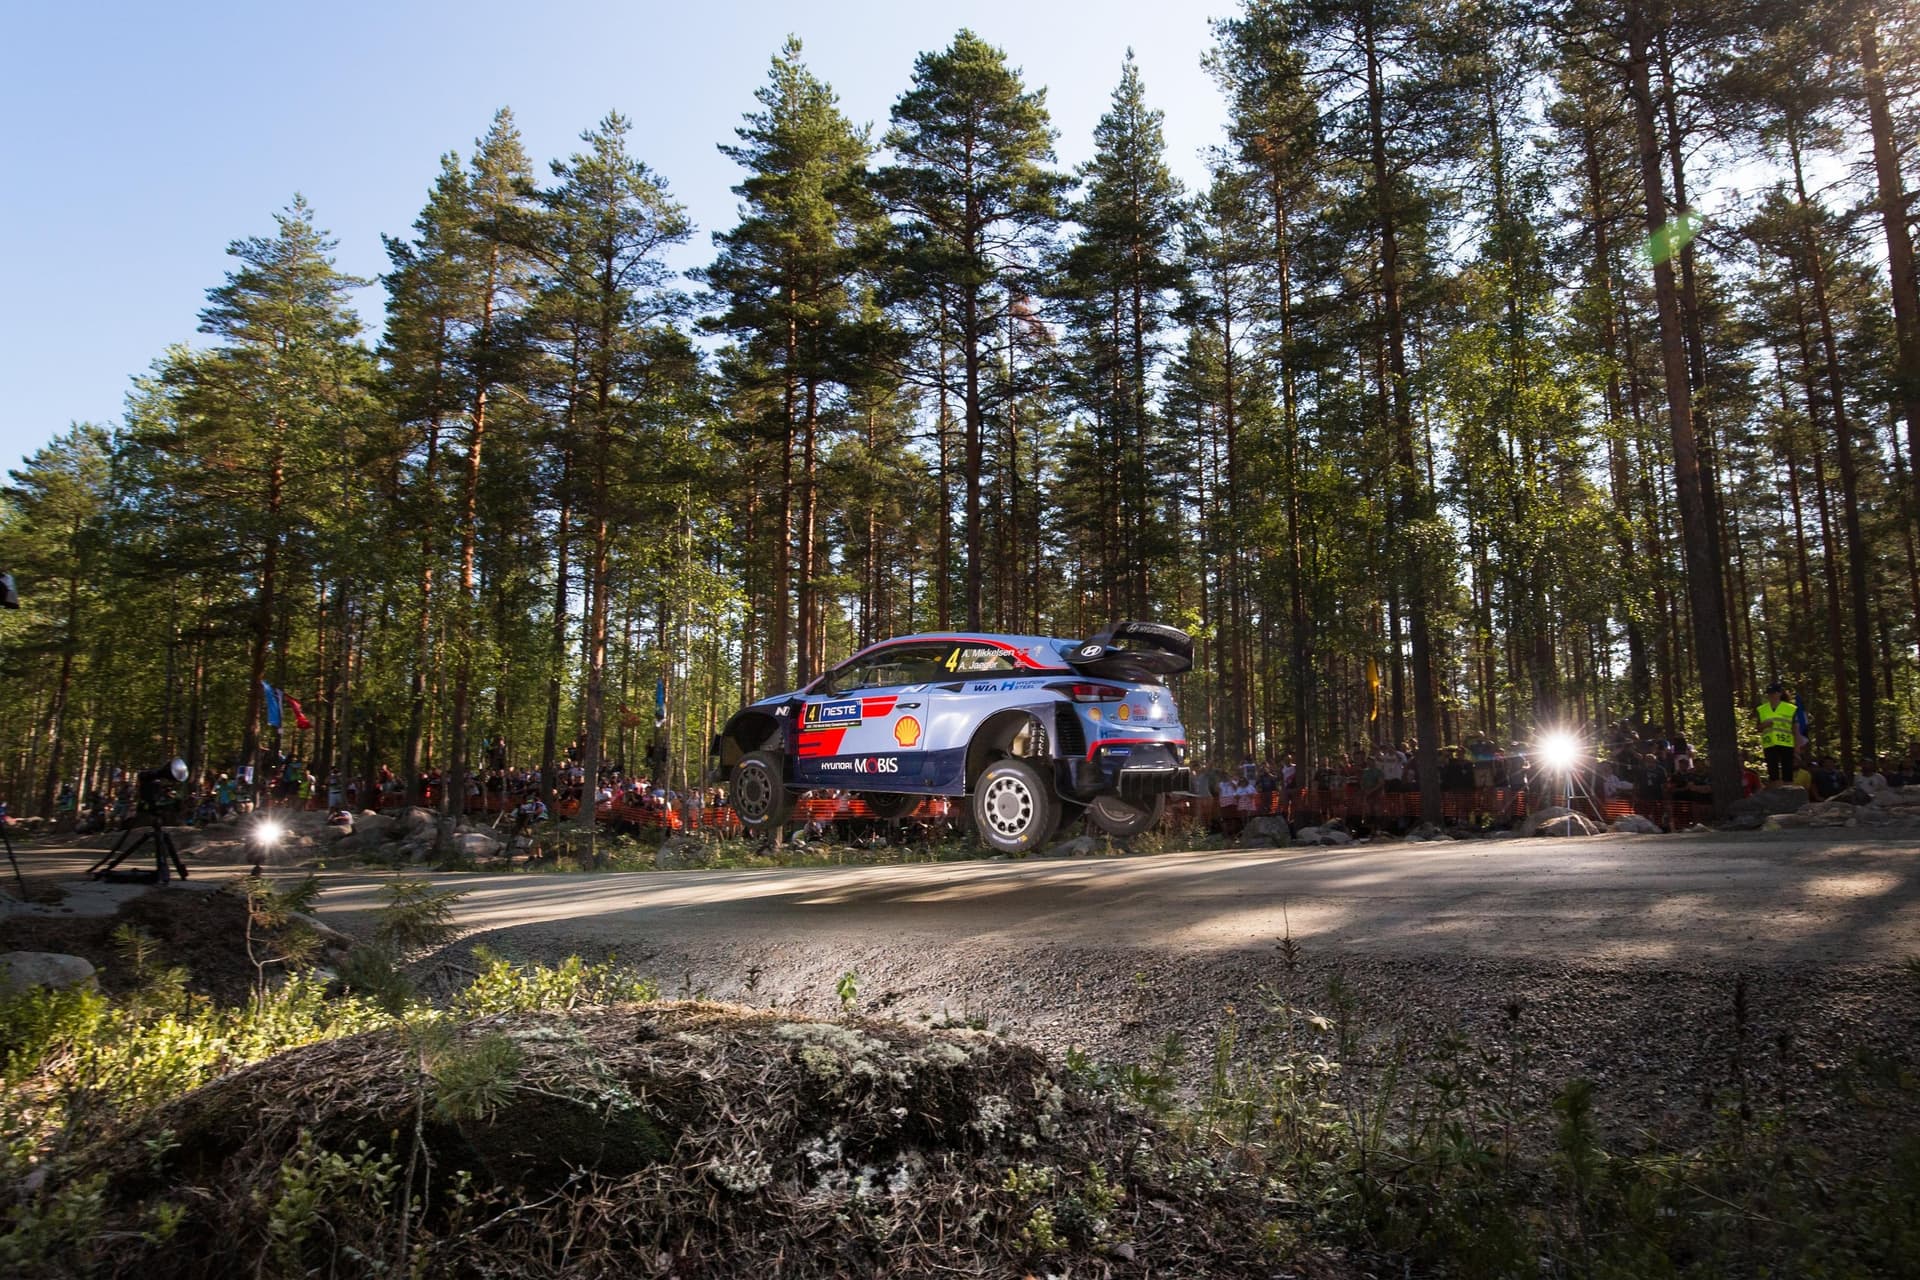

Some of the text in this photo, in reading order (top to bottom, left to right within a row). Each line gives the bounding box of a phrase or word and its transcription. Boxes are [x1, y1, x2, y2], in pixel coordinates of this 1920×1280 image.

[945, 648, 960, 672] 4
[962, 648, 1015, 658] A. Mikkelsen
[958, 662, 967, 670] A.
[809, 706, 816, 721] 4
[821, 757, 898, 774] HYUNDAI MOBIS
